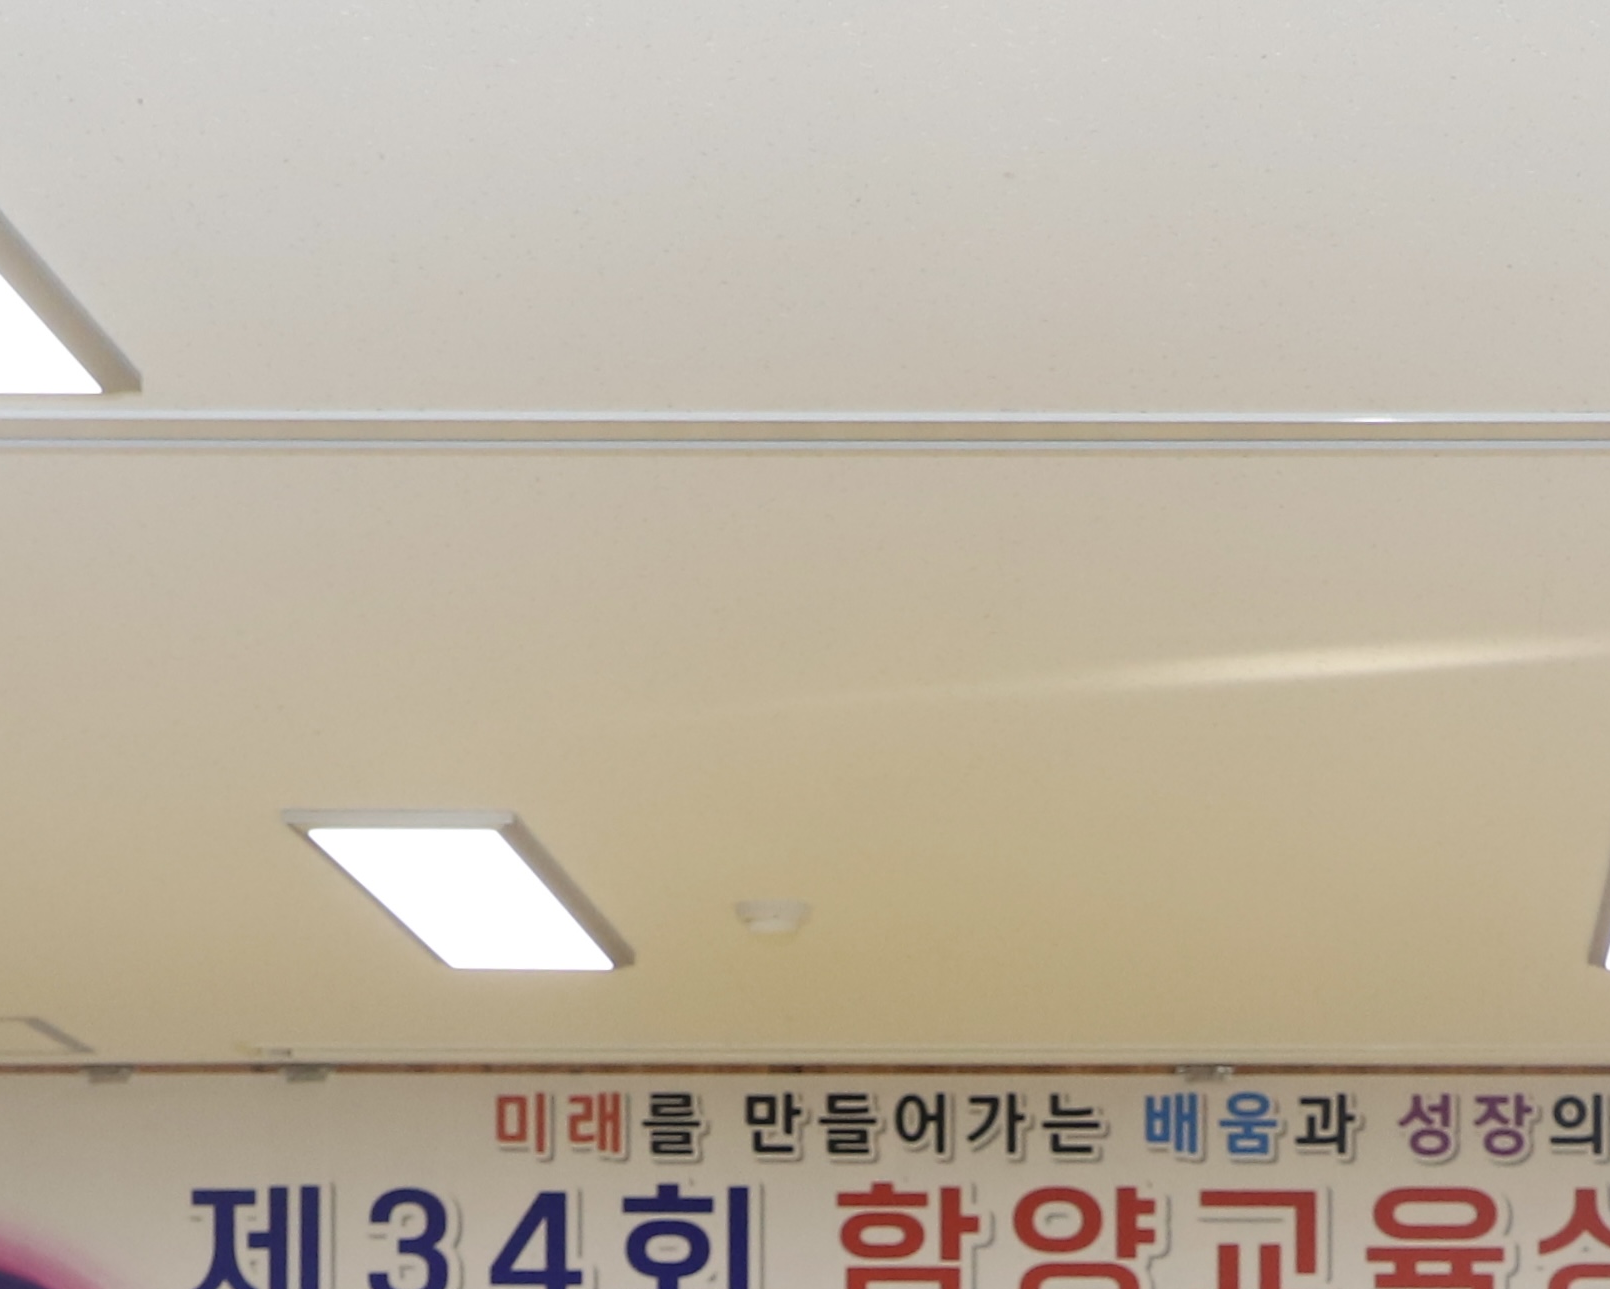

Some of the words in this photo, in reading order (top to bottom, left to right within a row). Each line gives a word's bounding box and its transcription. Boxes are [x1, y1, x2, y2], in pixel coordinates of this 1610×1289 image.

[494, 1091, 701, 1155] 미래를
[743, 1091, 1103, 1156] 만들어가는
[1145, 1092, 1357, 1156] 배움과
[1398, 1092, 1606, 1156] 성장의
